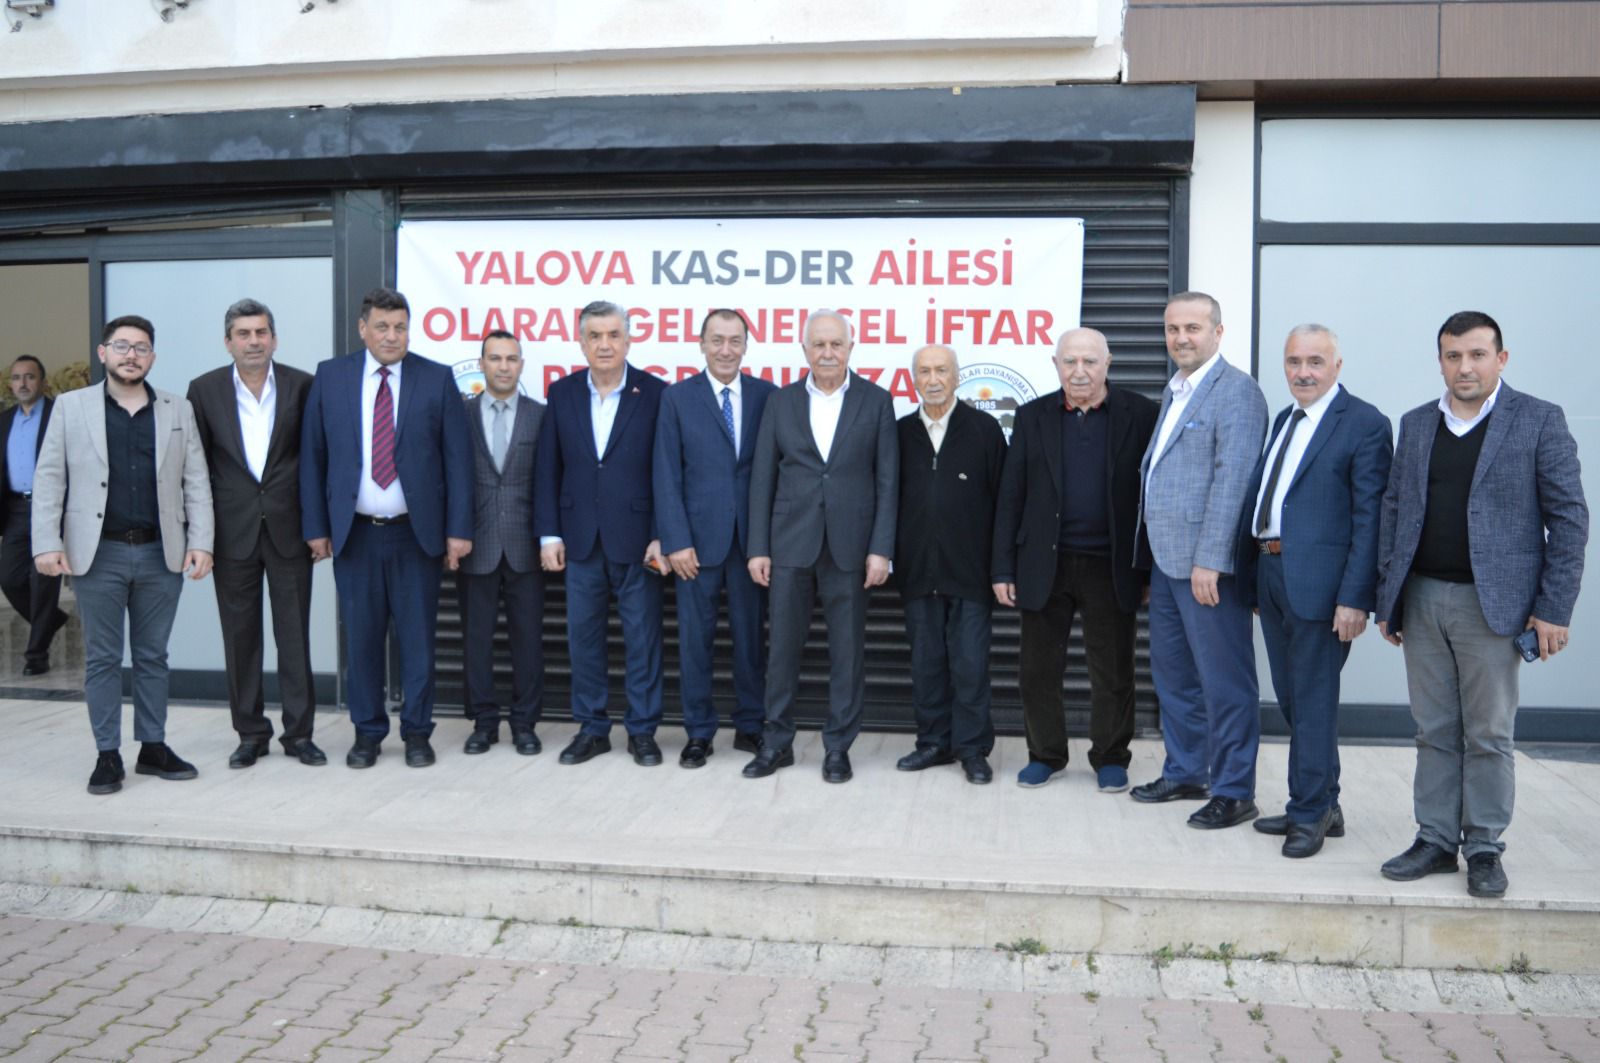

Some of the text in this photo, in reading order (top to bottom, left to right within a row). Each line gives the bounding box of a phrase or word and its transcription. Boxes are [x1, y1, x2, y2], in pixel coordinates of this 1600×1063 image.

[455, 238, 1014, 287] YALOVA KAS-DER AİLESİ
[422, 307, 583, 342] OLARA
[925, 297, 1055, 346] İFTAR
[975, 400, 997, 411] 1985
